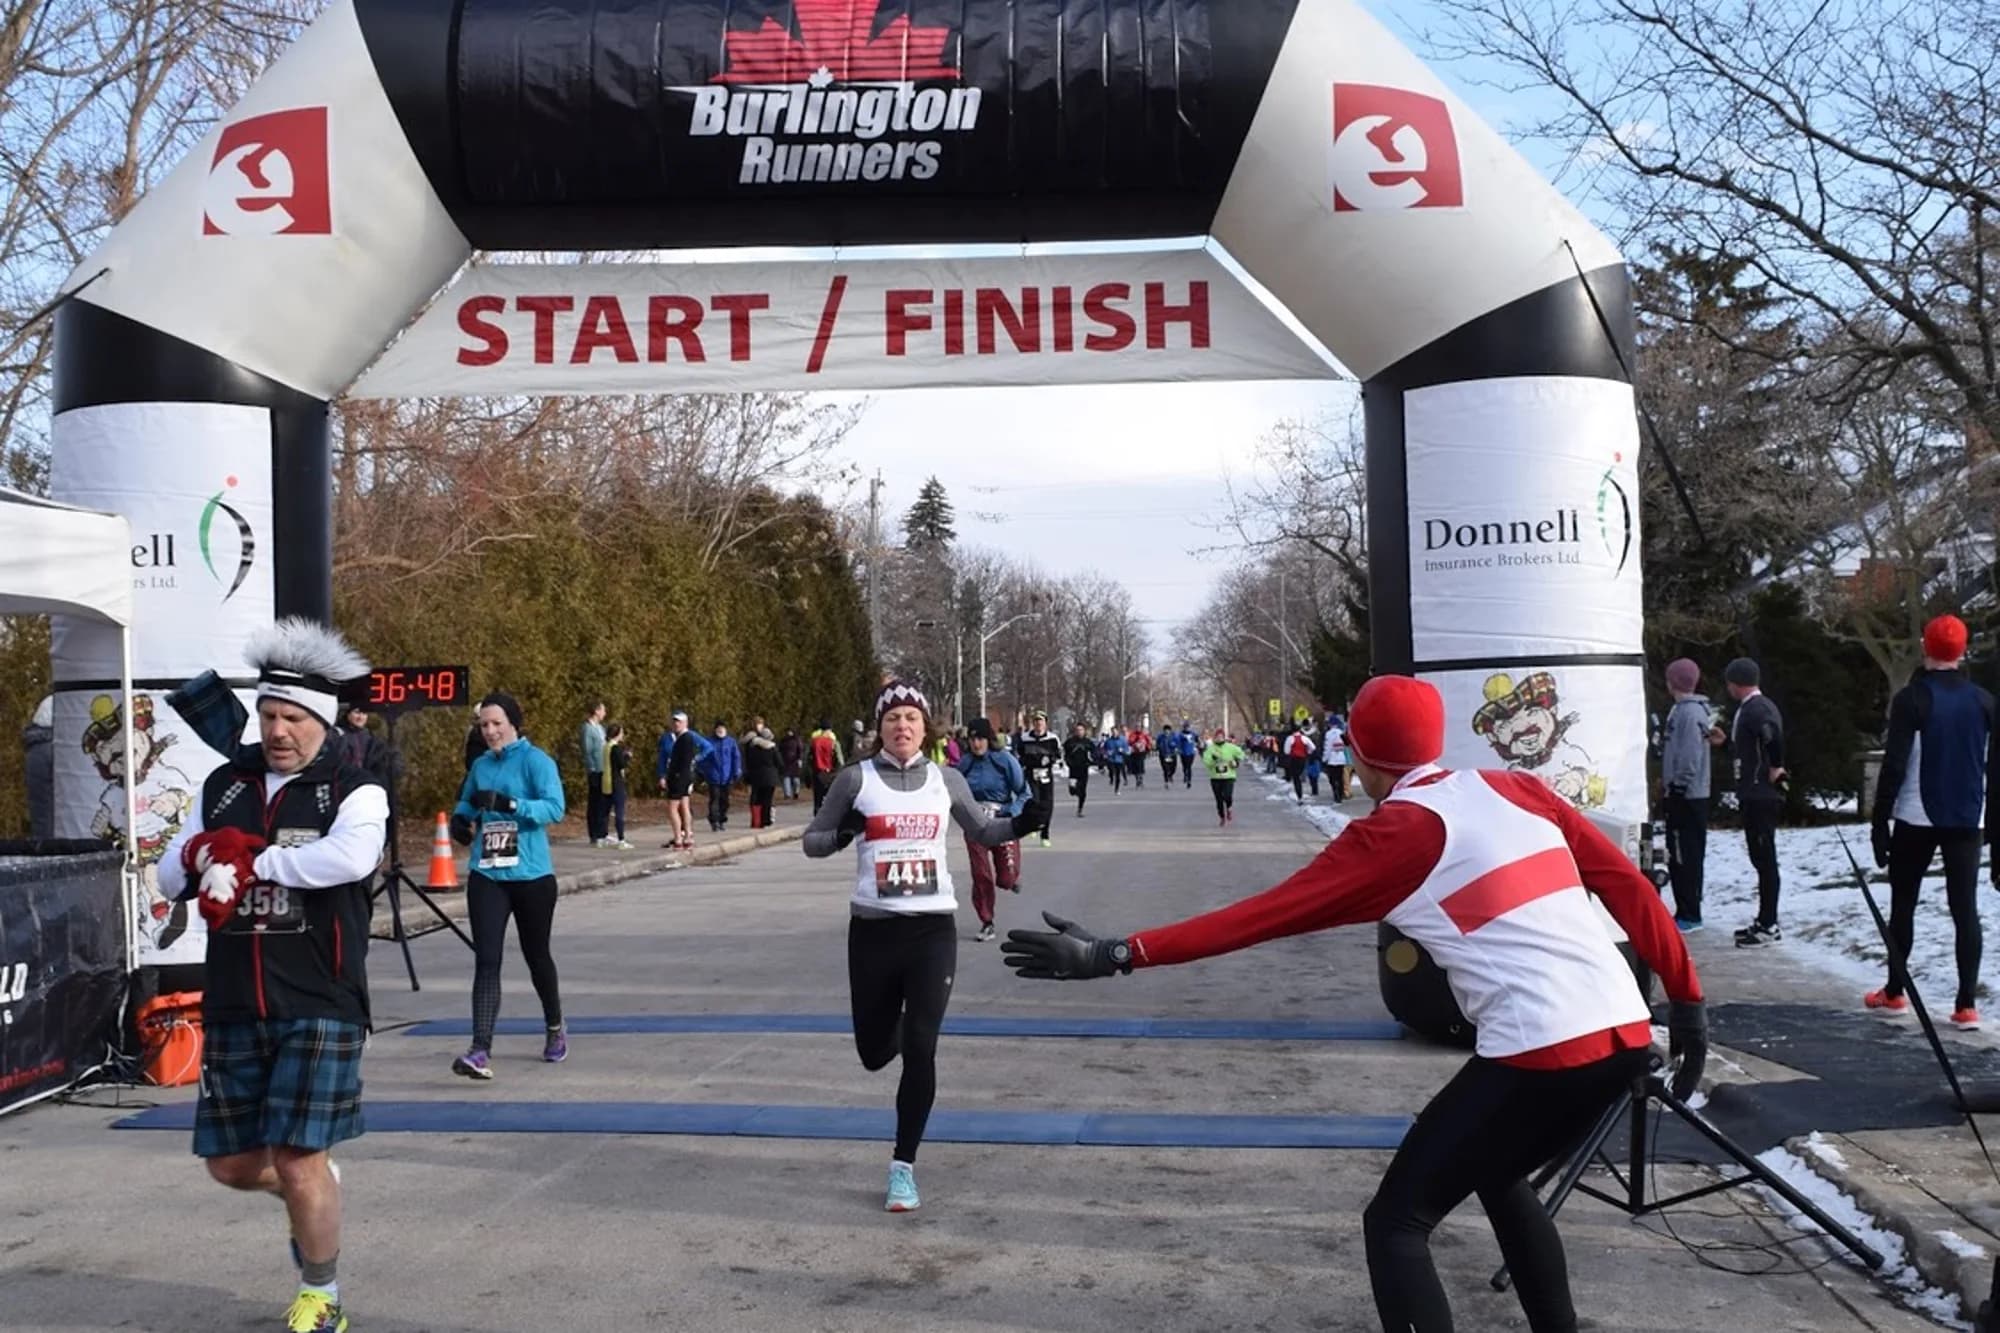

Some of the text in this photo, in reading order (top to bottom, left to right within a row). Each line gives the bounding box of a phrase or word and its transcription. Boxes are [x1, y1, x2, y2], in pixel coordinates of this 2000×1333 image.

[689, 81, 982, 139] Burlington
[738, 137, 942, 184] Runners
[457, 294, 770, 367] START
[885, 281, 1211, 356] FINISH
[1424, 509, 1580, 551] Donnell
[1425, 557, 1493, 572] Insurance
[1498, 553, 1553, 567] Brokers
[485, 833, 510, 850] 207
[887, 862, 927, 886] 441
[237, 886, 289, 916] 358
